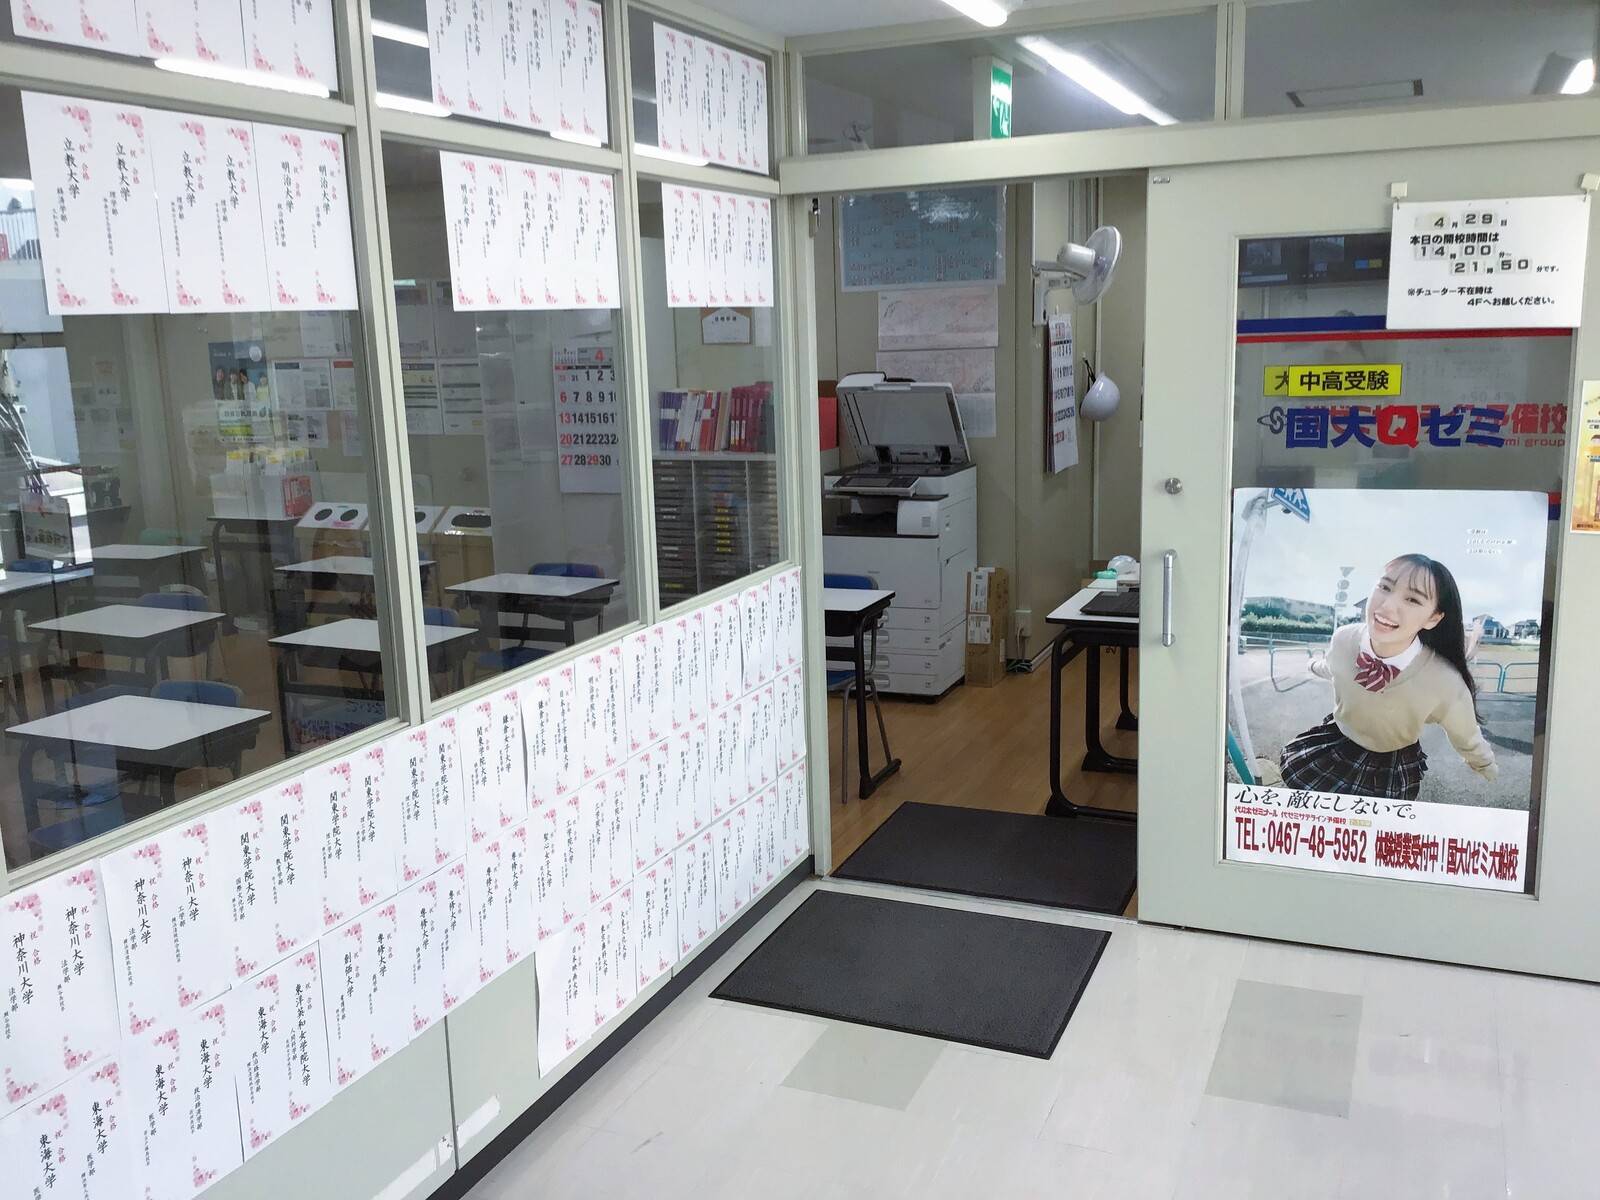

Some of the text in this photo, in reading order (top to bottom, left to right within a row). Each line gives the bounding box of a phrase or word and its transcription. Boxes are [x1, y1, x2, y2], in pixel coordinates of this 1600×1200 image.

[64, 137, 80, 199] 立教大学
[116, 142, 131, 202] 立教大学
[183, 151, 196, 207] 立教大学
[226, 154, 239, 208] 立教大学
[281, 161, 294, 213] 明治大学
[319, 165, 331, 215] 明治大学
[1410, 232, 1499, 245] 本日の開校時間は
[560, 392, 605, 402] 6 7 8 9
[597, 371, 603, 381] 2
[1300, 371, 1389, 391] 中高受験
[560, 413, 609, 424] 13 14 15 16
[560, 434, 610, 445] 20 21 22 23
[1286, 405, 1505, 449] 国大Qゼミ
[561, 455, 611, 466] 27 28 29 30
[439, 743, 449, 805] 関東学院大学
[477, 726, 487, 787] 関東学院大学
[364, 775, 376, 842] 関東学院大学
[410, 756, 420, 821] 関東学院大学
[1235, 786, 1417, 821] 心を、敵にしないで。
[280, 813, 295, 885] 関東学院大学
[329, 790, 342, 860] 関東学院大学
[182, 856, 199, 921] 神奈川大学
[240, 832, 256, 906] 関東学院大学
[134, 877, 151, 945] 神奈川大学
[12, 932, 34, 1005] 神奈川大学
[65, 906, 85, 977] 神奈川大学
[377, 933, 387, 977] 専修大学
[257, 1006, 270, 1054] 東海大学
[295, 983, 311, 1087] 東洋英和女学院大学
[154, 1064, 169, 1116] 東海大学
[200, 1039, 214, 1089] 東海大学
[92, 1101, 108, 1154] 東海大学
[39, 1134, 56, 1189] 東海大学
